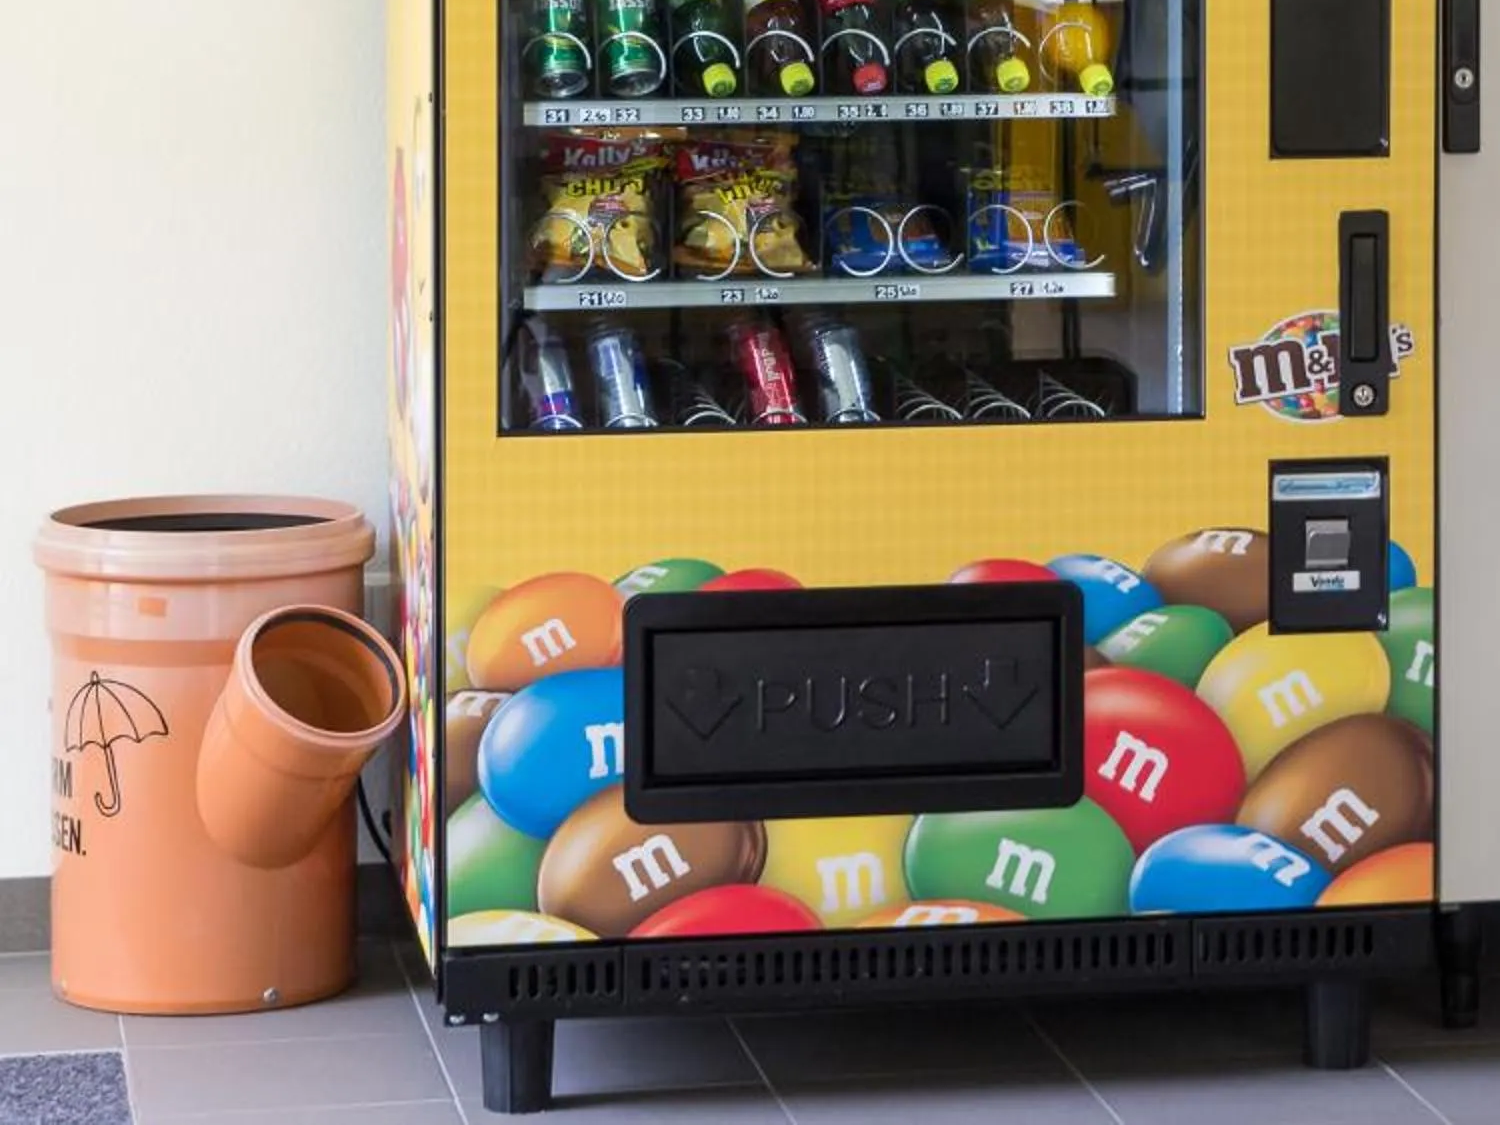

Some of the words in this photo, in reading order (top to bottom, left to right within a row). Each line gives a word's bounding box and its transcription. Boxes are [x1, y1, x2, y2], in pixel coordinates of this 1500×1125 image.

[546, 109, 568, 123] 31
[682, 107, 704, 121] 33
[758, 107, 778, 119] 34
[521, 618, 576, 667] m
[756, 672, 952, 734] PUSH
[1257, 669, 1324, 729] m
[1098, 730, 1169, 803] m
[1301, 787, 1380, 864] m
[613, 833, 691, 904] m
[816, 851, 886, 912] m
[985, 837, 1056, 904] m
[1237, 832, 1311, 887] m
